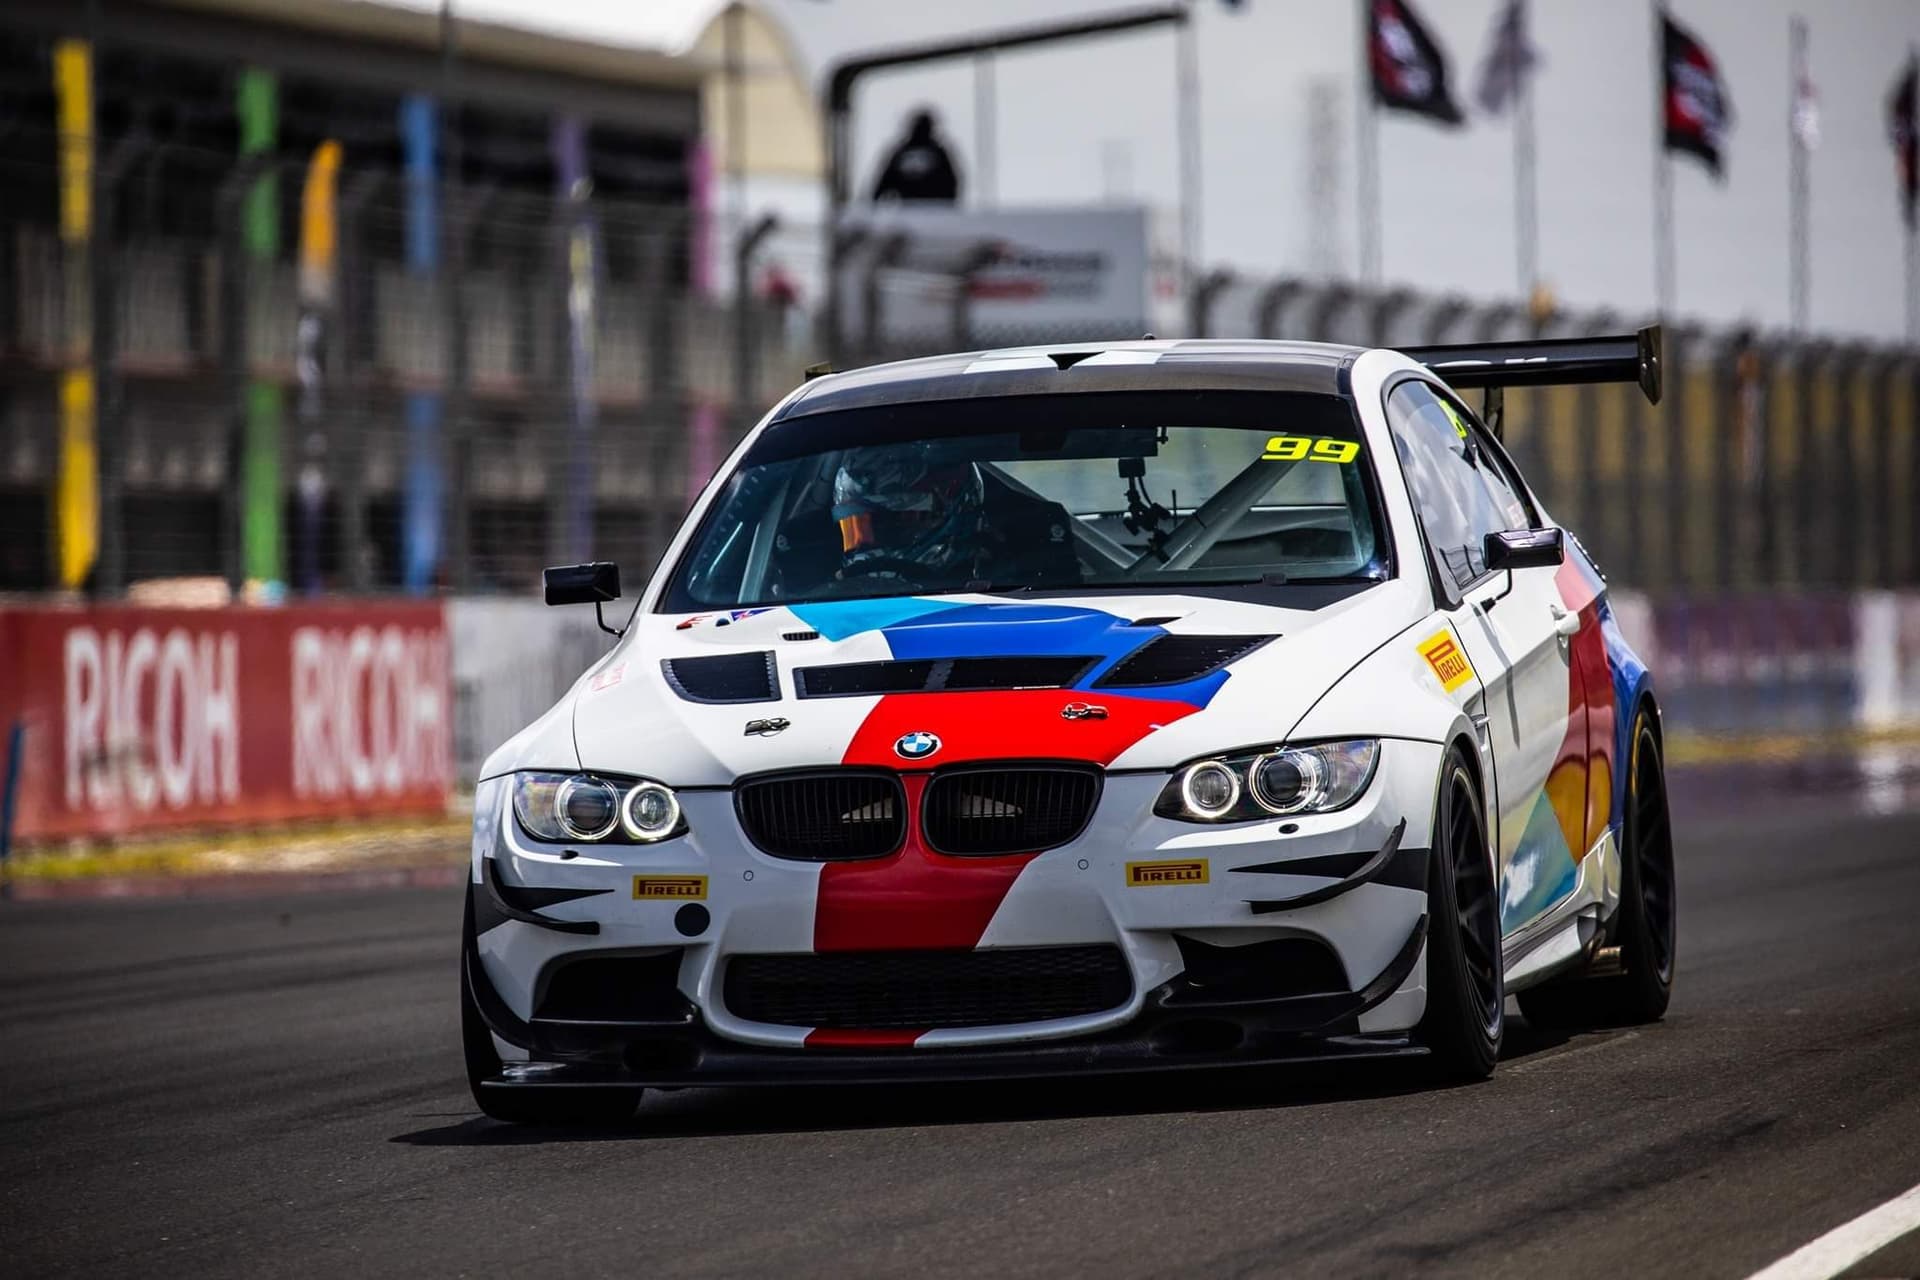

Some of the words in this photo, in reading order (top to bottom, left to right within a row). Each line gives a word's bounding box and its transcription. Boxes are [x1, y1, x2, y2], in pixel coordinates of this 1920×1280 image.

[1261, 437, 1360, 463] 99
[1425, 639, 1467, 684] PIRELLI
[65, 625, 240, 812] RICOH
[290, 625, 447, 796] RICOH
[638, 880, 702, 896] PIRELLI
[1133, 864, 1202, 882] PIRELLI
